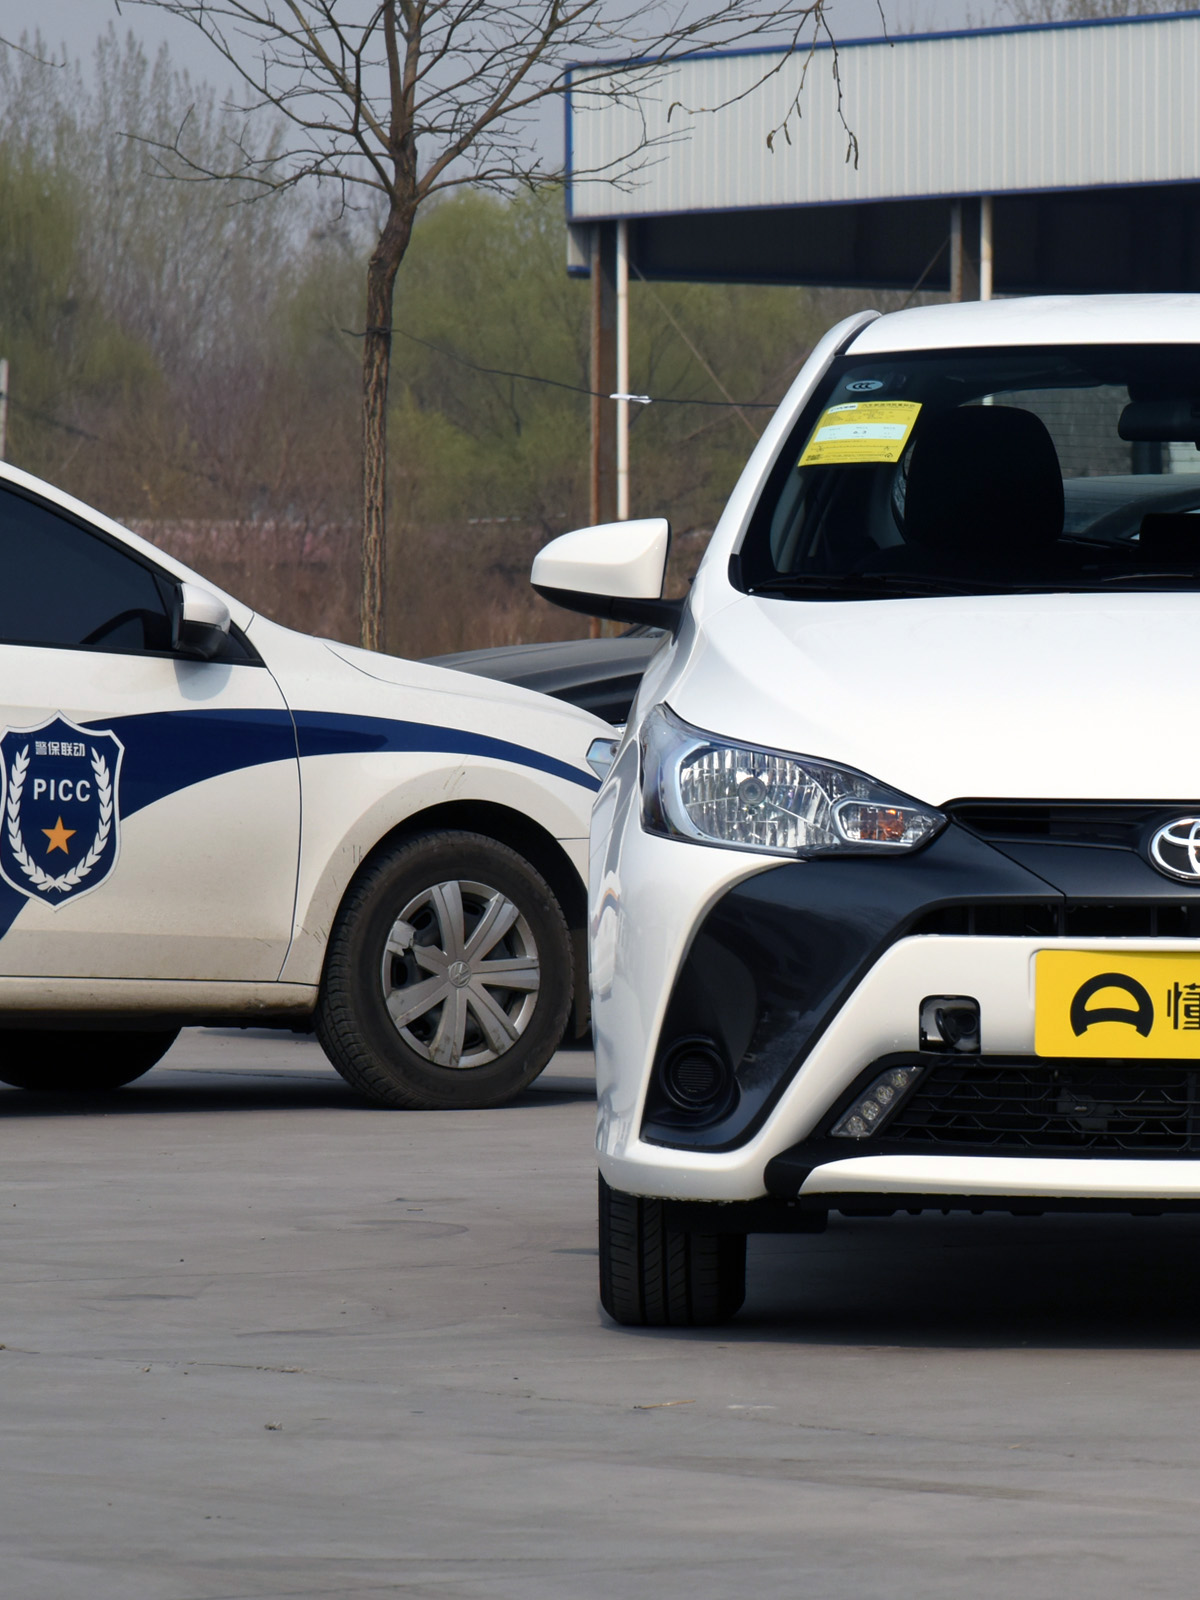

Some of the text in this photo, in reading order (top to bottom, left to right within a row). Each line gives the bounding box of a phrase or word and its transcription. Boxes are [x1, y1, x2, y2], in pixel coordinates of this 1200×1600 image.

[35, 741, 86, 757] 警保联动
[33, 779, 91, 802] PICC
